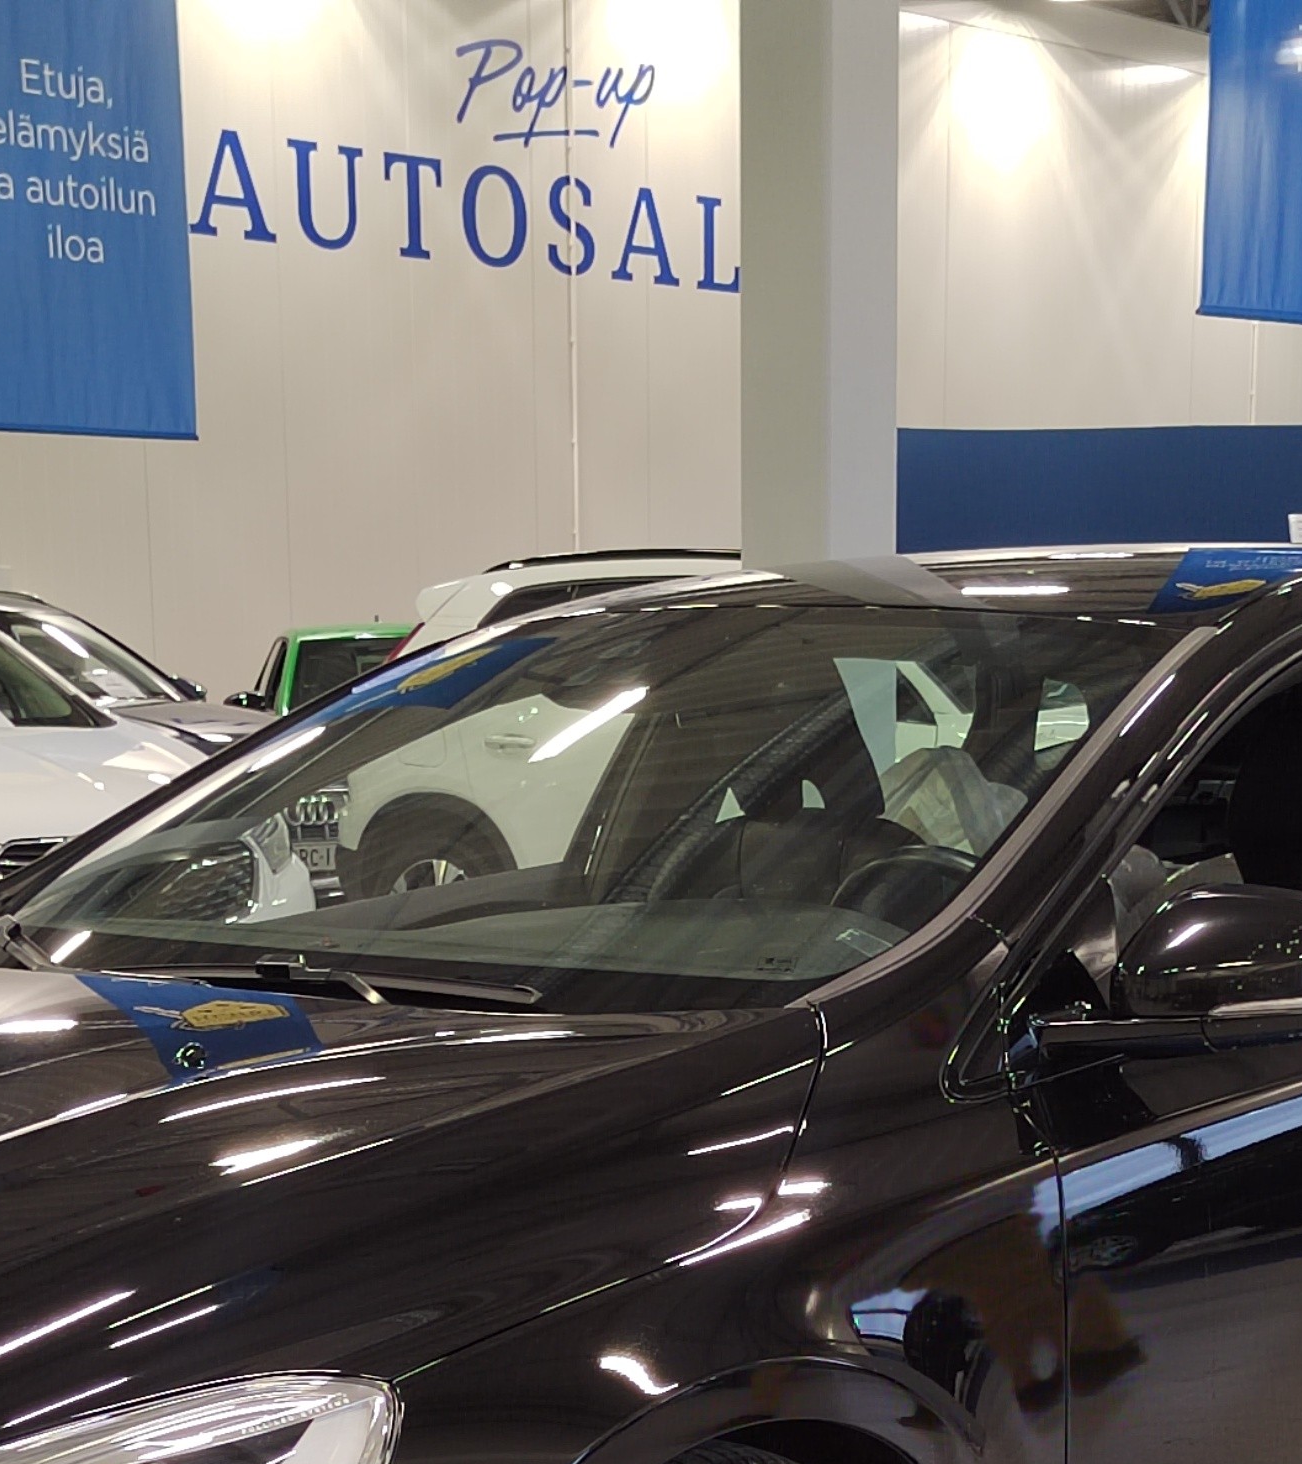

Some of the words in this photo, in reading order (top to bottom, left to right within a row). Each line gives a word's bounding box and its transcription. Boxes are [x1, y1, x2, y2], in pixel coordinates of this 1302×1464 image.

[19, 58, 113, 110] Etuja,
[455, 38, 656, 149] Pop-up
[25, 173, 157, 217] autoilun
[189, 129, 741, 294] AUTOSAL
[47, 223, 105, 264] iloa
